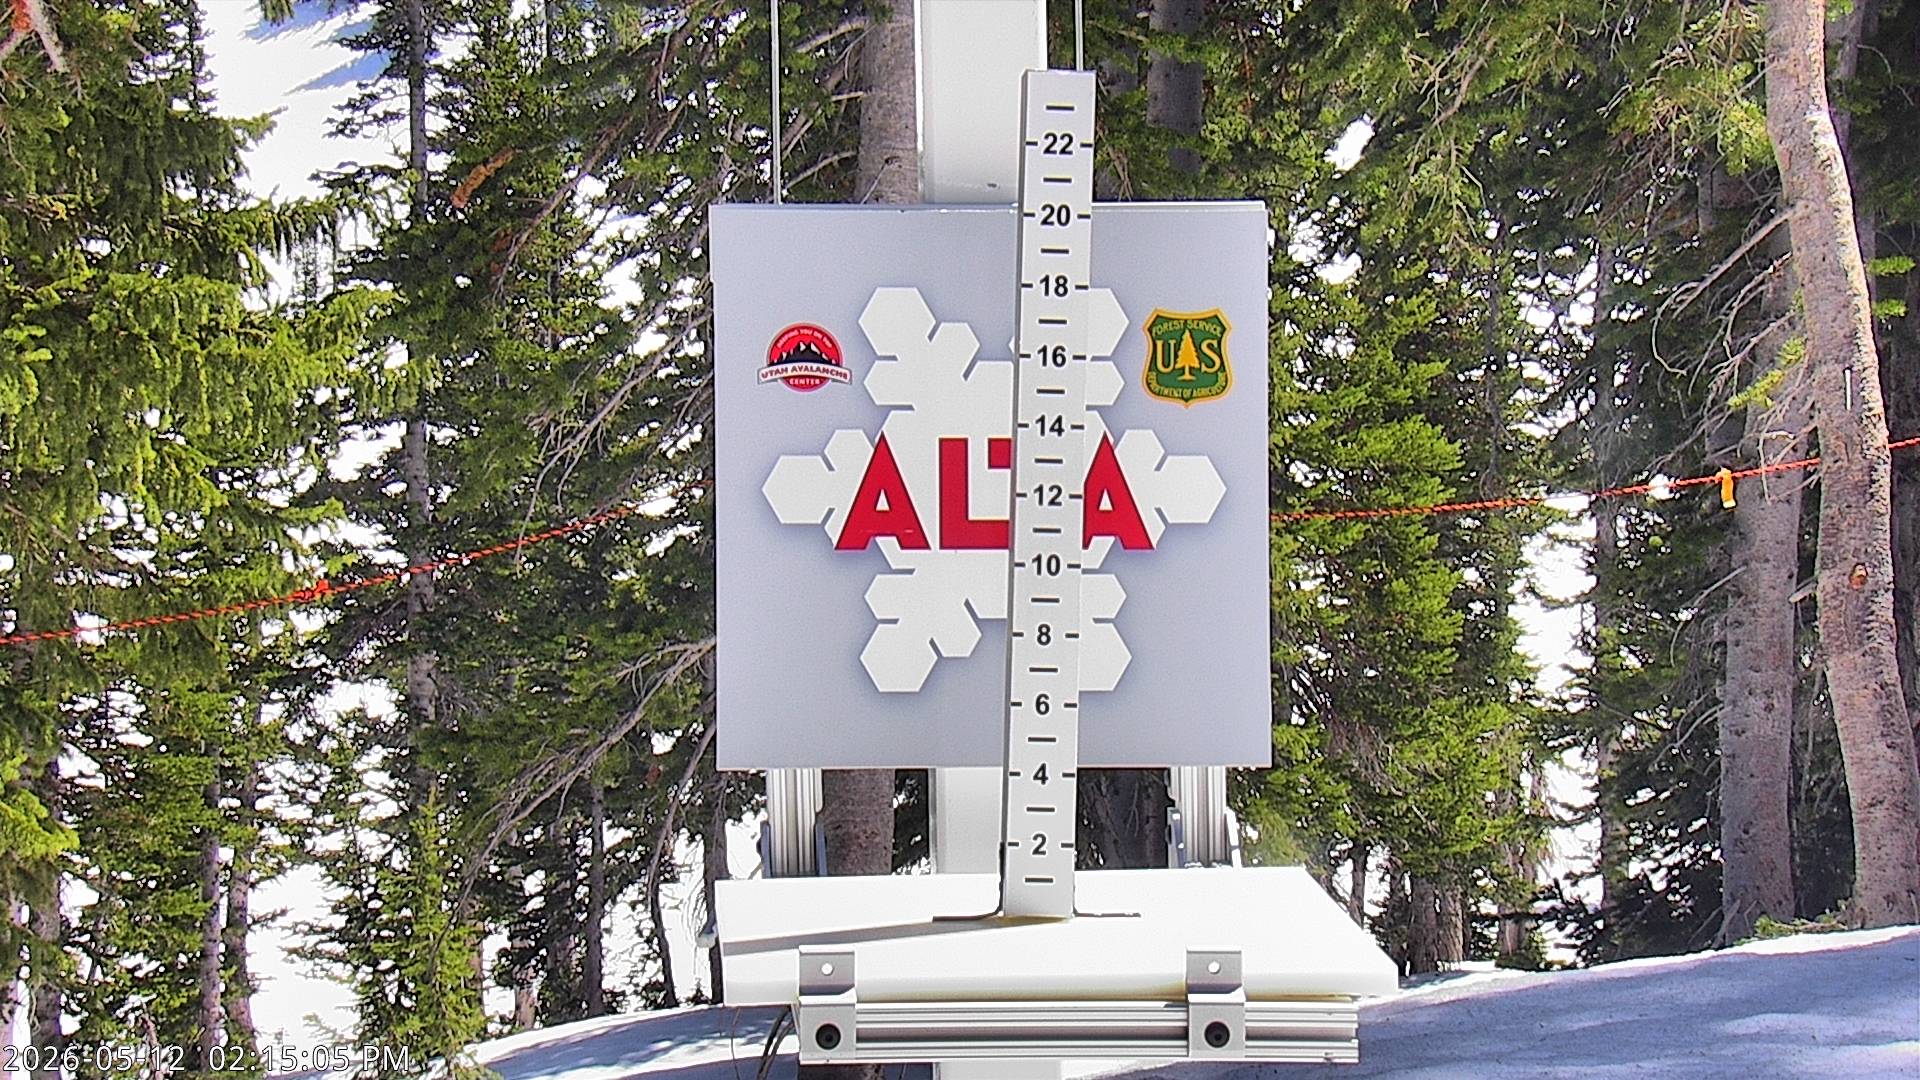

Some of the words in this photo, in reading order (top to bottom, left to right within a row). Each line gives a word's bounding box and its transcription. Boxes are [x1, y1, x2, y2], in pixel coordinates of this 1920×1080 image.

[1043, 132, 1074, 156] 22
[1040, 203, 1071, 227] 20
[1039, 274, 1069, 298] 18
[1152, 320, 1185, 338] FOREST
[1037, 344, 1067, 368] 16
[761, 366, 789, 379] UTAH
[790, 364, 848, 380] AVALANCHE
[789, 378, 820, 386] CENTER
[1035, 414, 1065, 437] 14
[834, 430, 1156, 550] ALA
[1033, 484, 1063, 507] 12
[1031, 553, 1061, 577] 10
[1036, 623, 1052, 646] 8
[1035, 693, 1050, 716] 6
[1032, 763, 1049, 785] 4
[1032, 833, 1047, 856] 2
